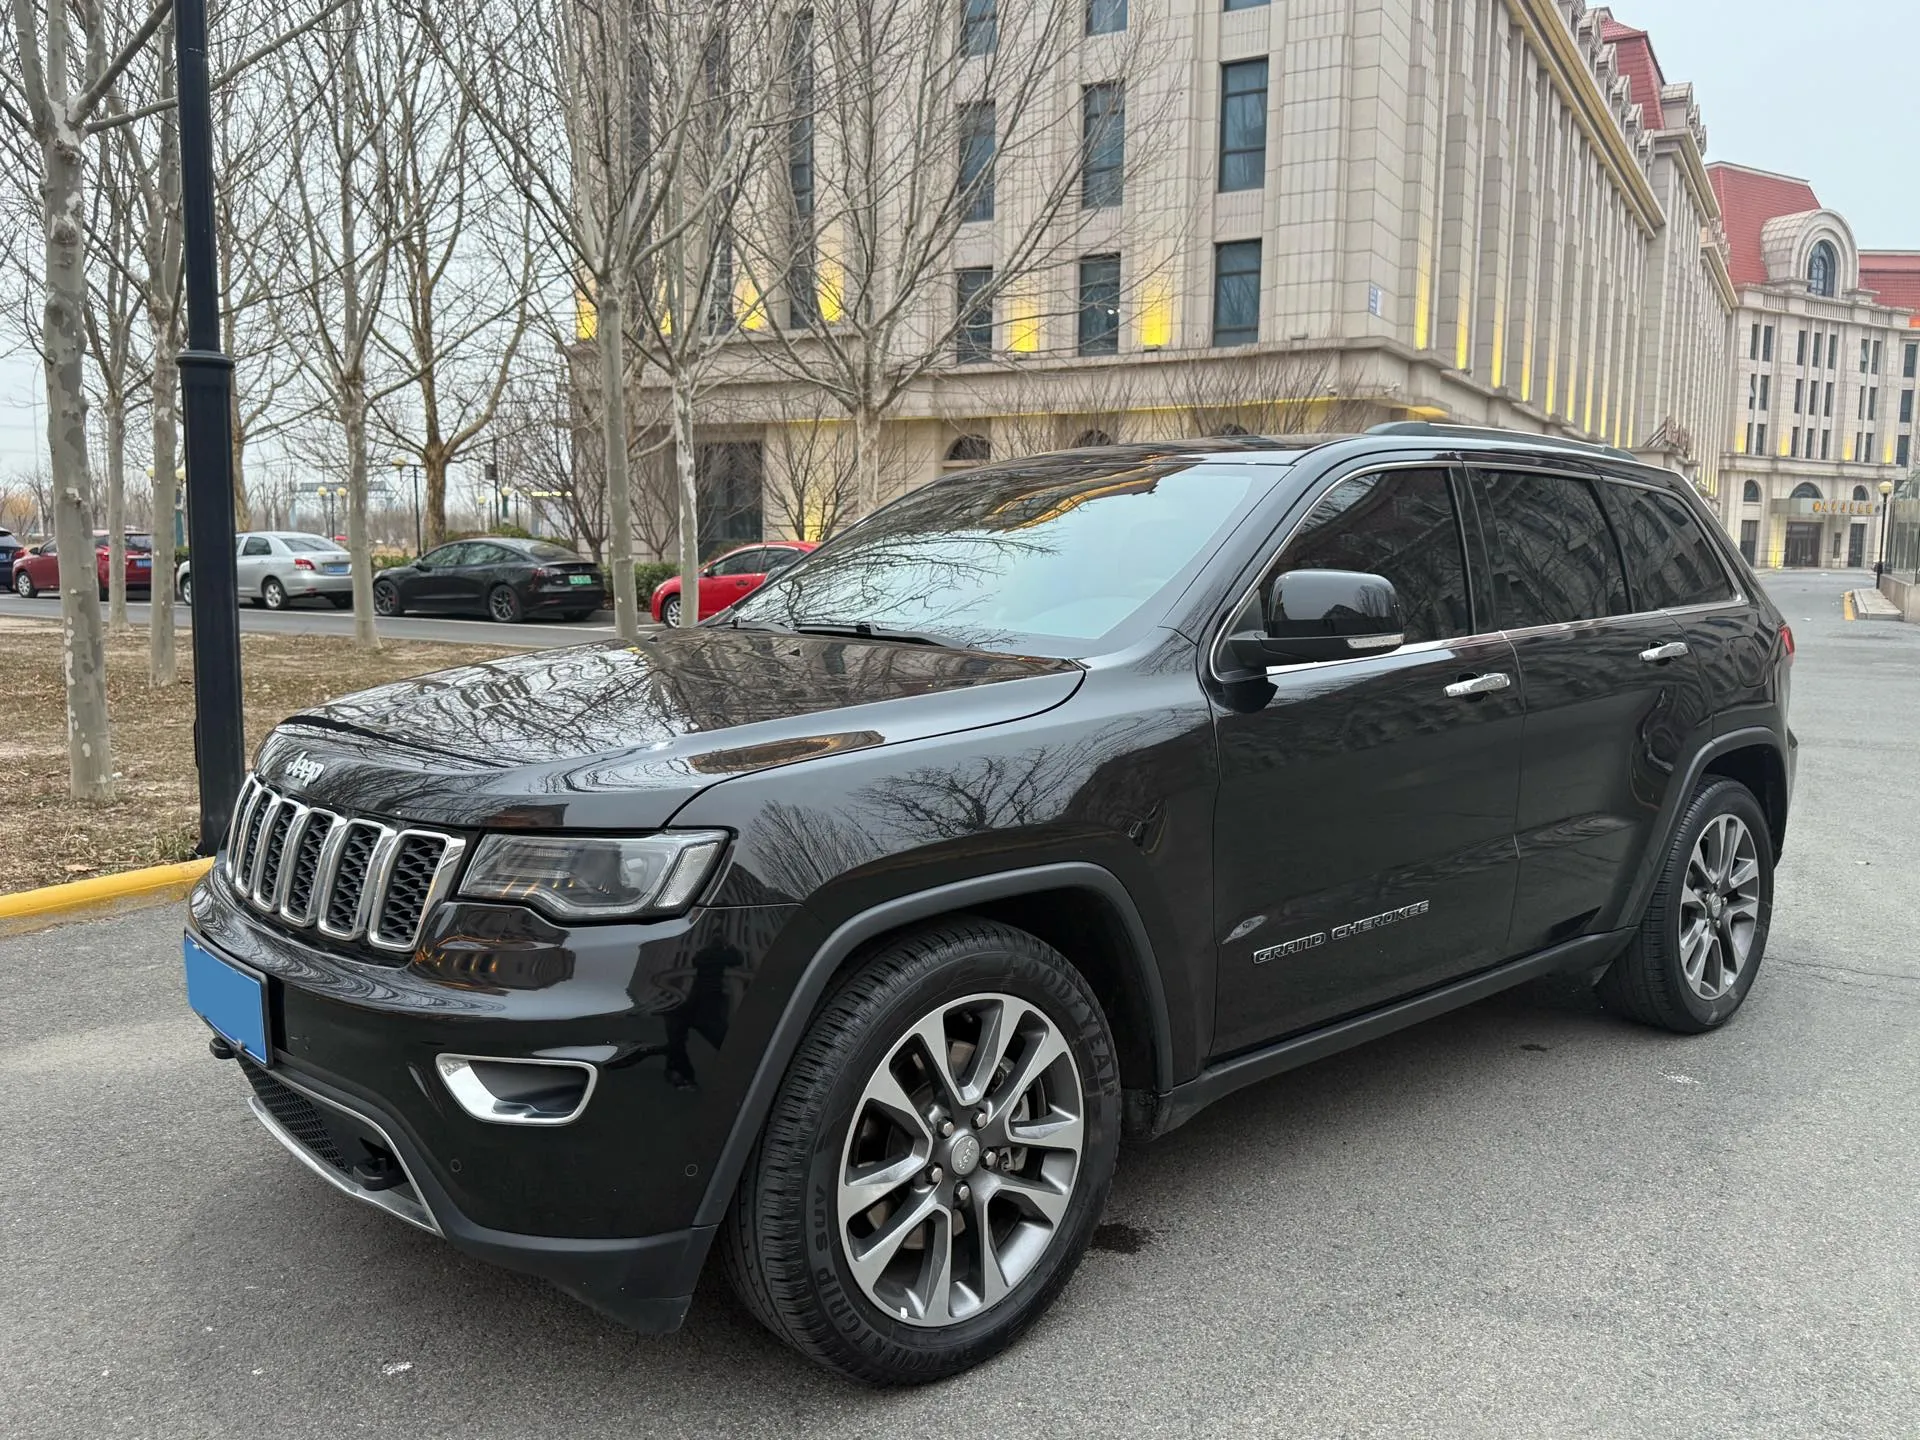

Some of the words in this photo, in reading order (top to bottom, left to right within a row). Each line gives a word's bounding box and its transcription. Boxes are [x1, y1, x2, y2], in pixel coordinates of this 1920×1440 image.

[285, 750, 325, 787] Jeep
[1253, 932, 1326, 964] GRAND
[1331, 899, 1430, 940] CHEROKEE
[814, 1183, 829, 1252] SUV
